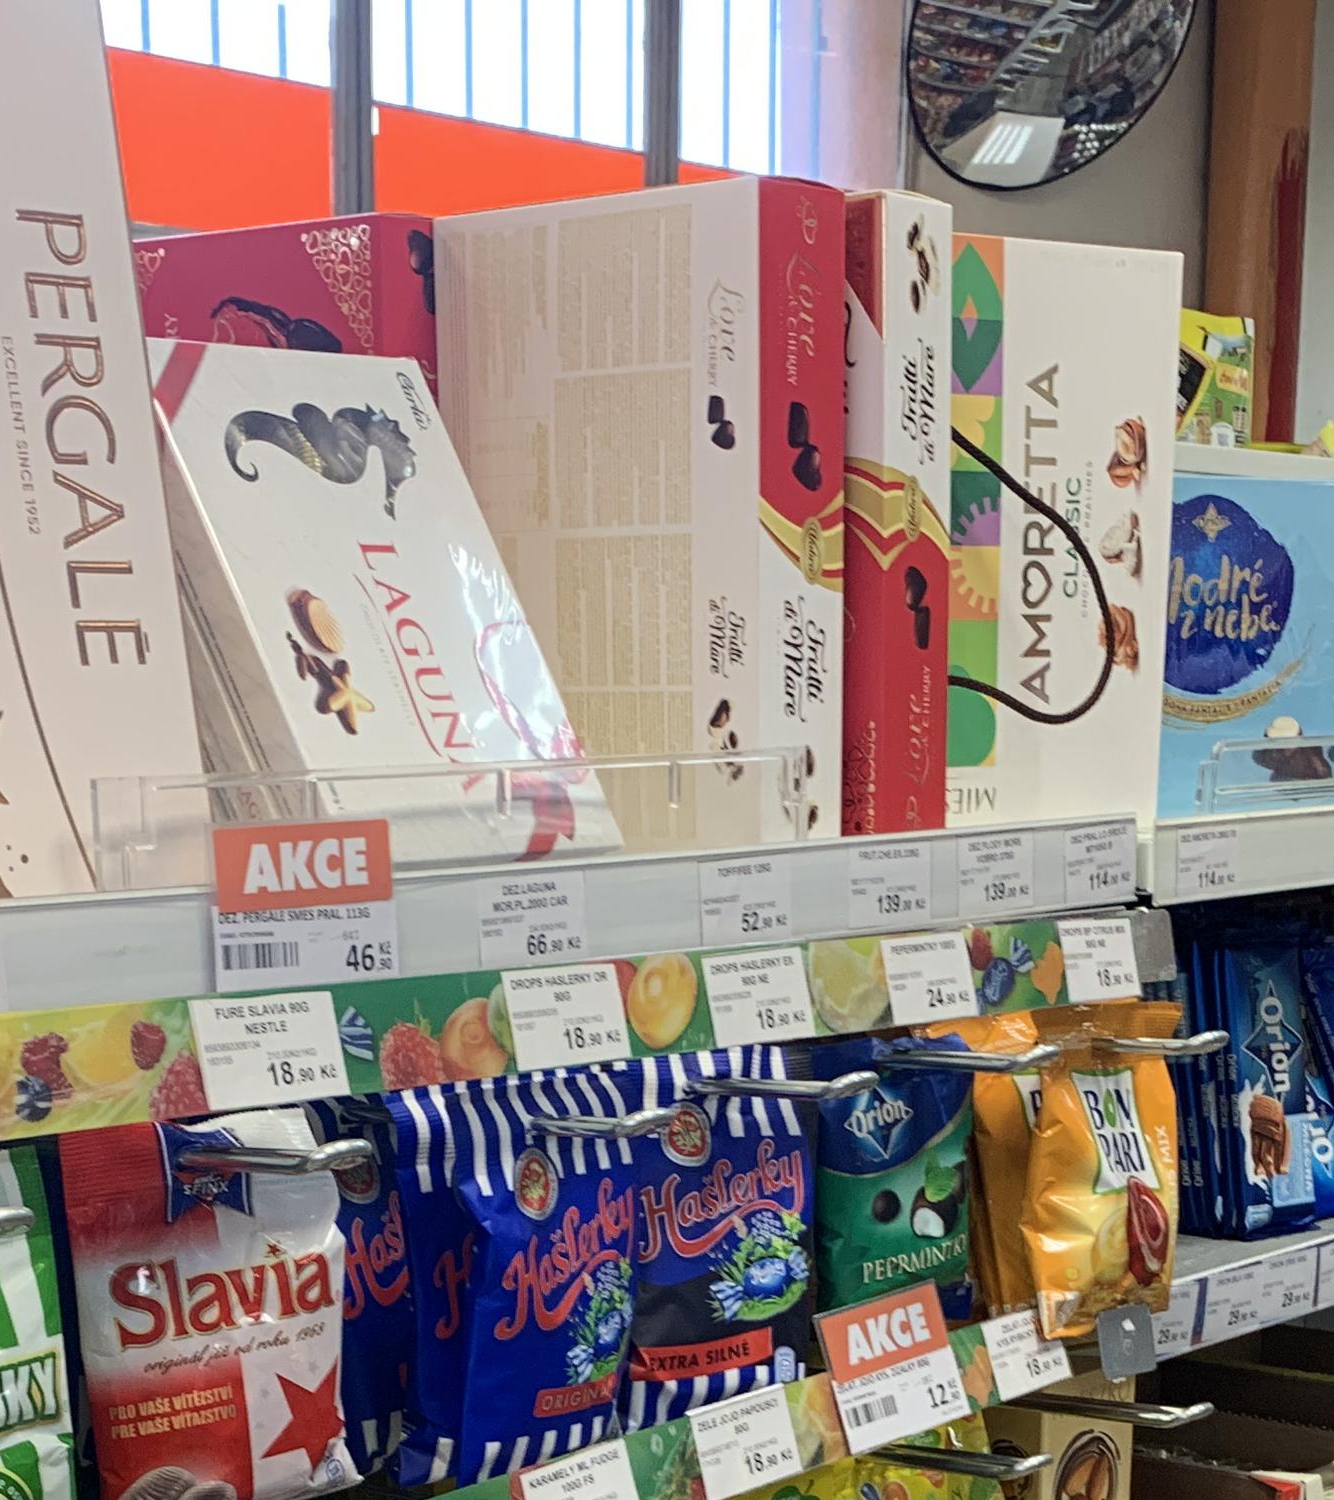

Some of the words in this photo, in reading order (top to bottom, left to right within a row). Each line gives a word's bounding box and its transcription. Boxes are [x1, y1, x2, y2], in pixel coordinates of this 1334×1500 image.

[1, 336, 25, 432] EXCELLENT
[16, 440, 35, 493] SINCE
[24, 496, 42, 536] 1952
[243, 836, 370, 895] AKCE
[215, 1006, 245, 1022] FURE
[247, 1002, 285, 1018] SLAVIA
[245, 1020, 289, 1036] NESTLE
[606, 1027, 622, 1044] Kč
[1080, 1083, 1134, 1128] BON
[638, 1137, 807, 1265] Hašlerky
[108, 1247, 337, 1351] Slavia
[648, 1348, 701, 1373] EXTRA
[704, 1339, 750, 1364] SILNÉ
[845, 1304, 930, 1367] AKCE
